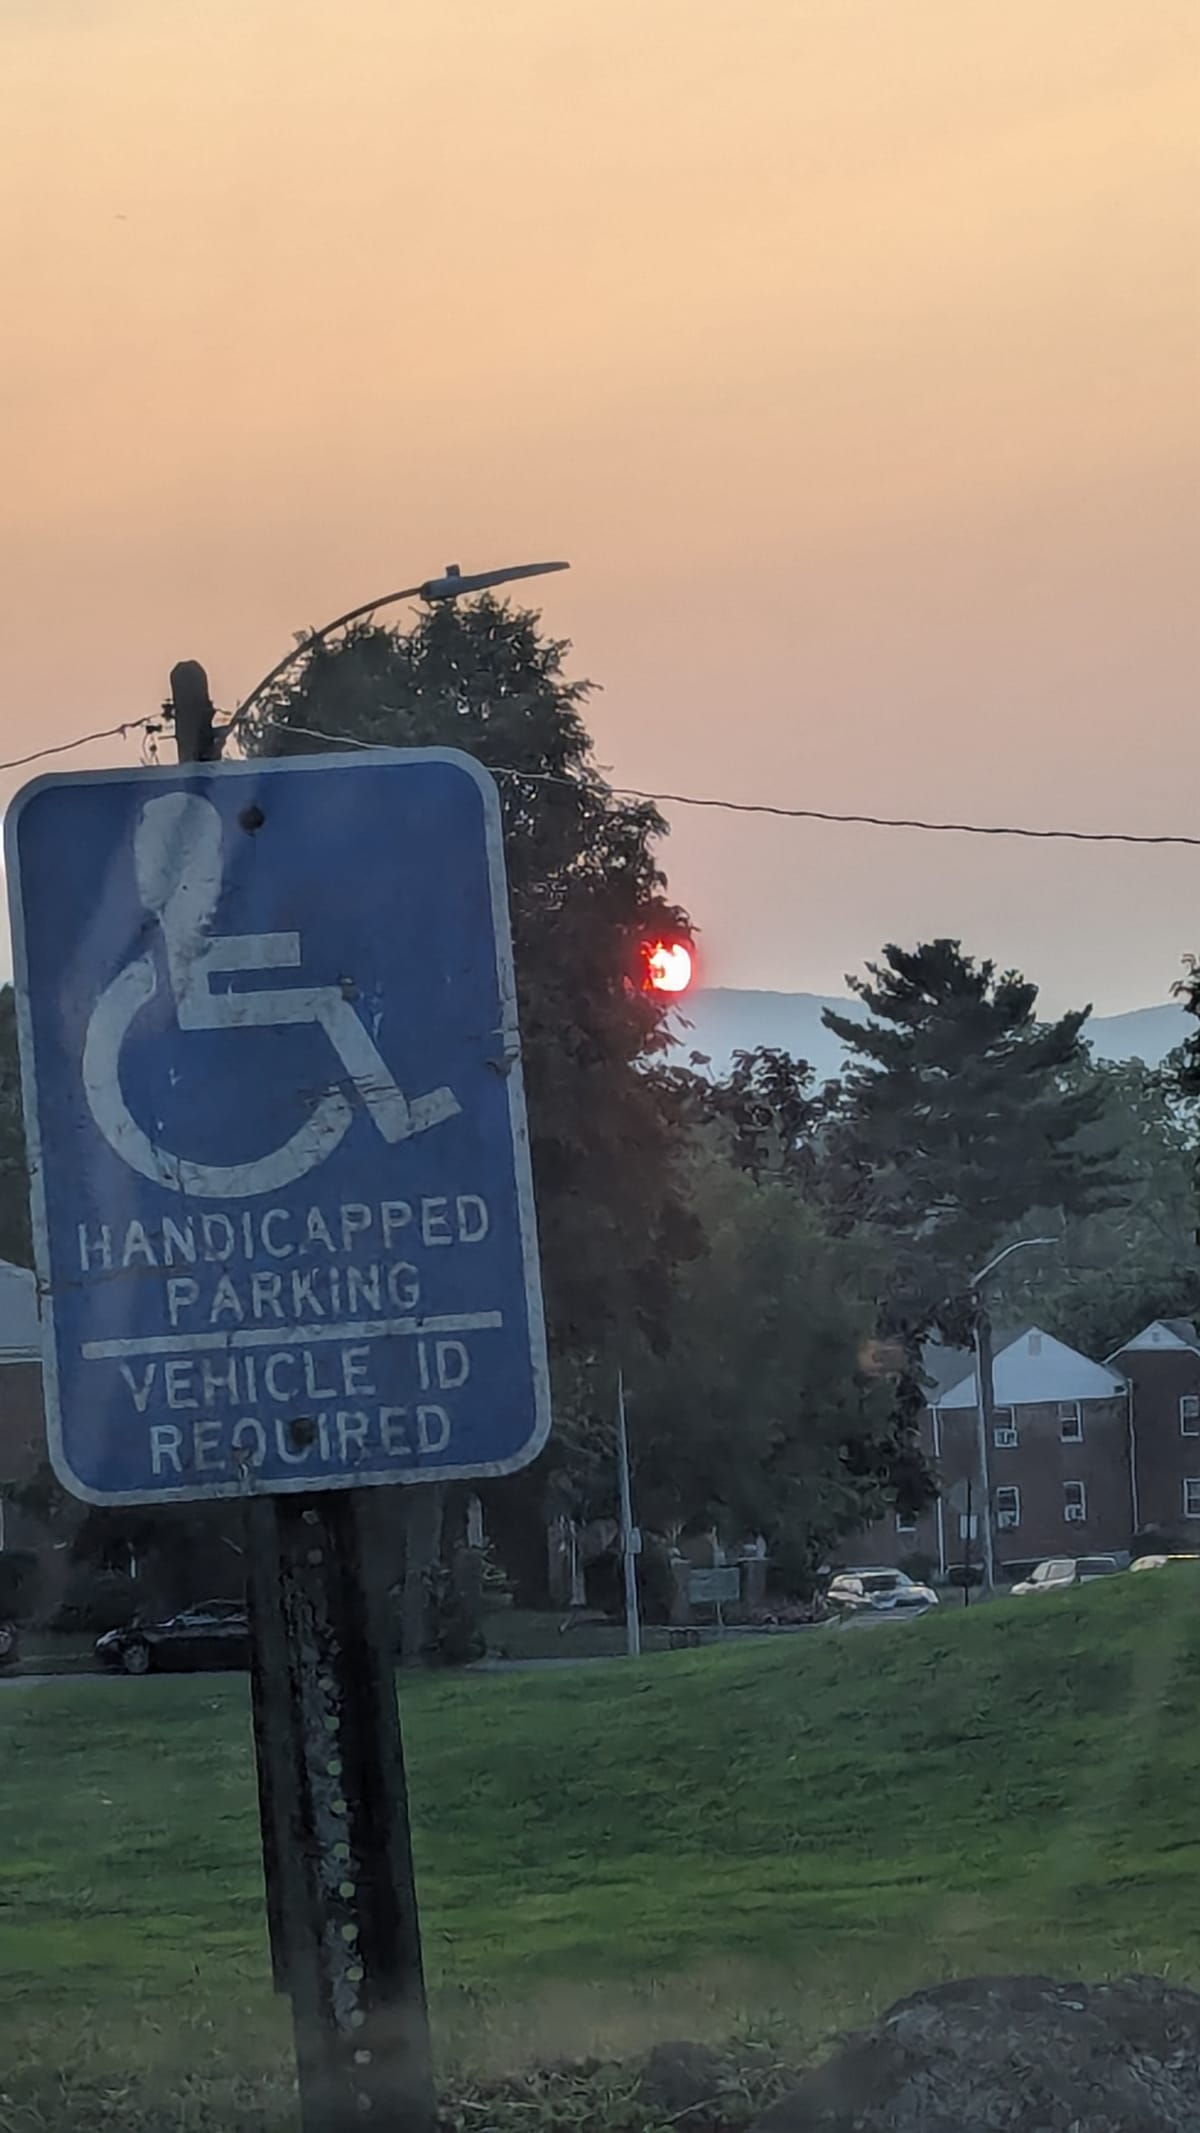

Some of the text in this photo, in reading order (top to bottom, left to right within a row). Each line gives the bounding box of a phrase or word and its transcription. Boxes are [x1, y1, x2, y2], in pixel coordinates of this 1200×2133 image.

[77, 1195, 489, 1271] HANDICAPPED
[167, 1262, 420, 1326] PARKING
[120, 1340, 470, 1412] VEHICLE ID
[150, 1404, 451, 1475] REQUIRED
